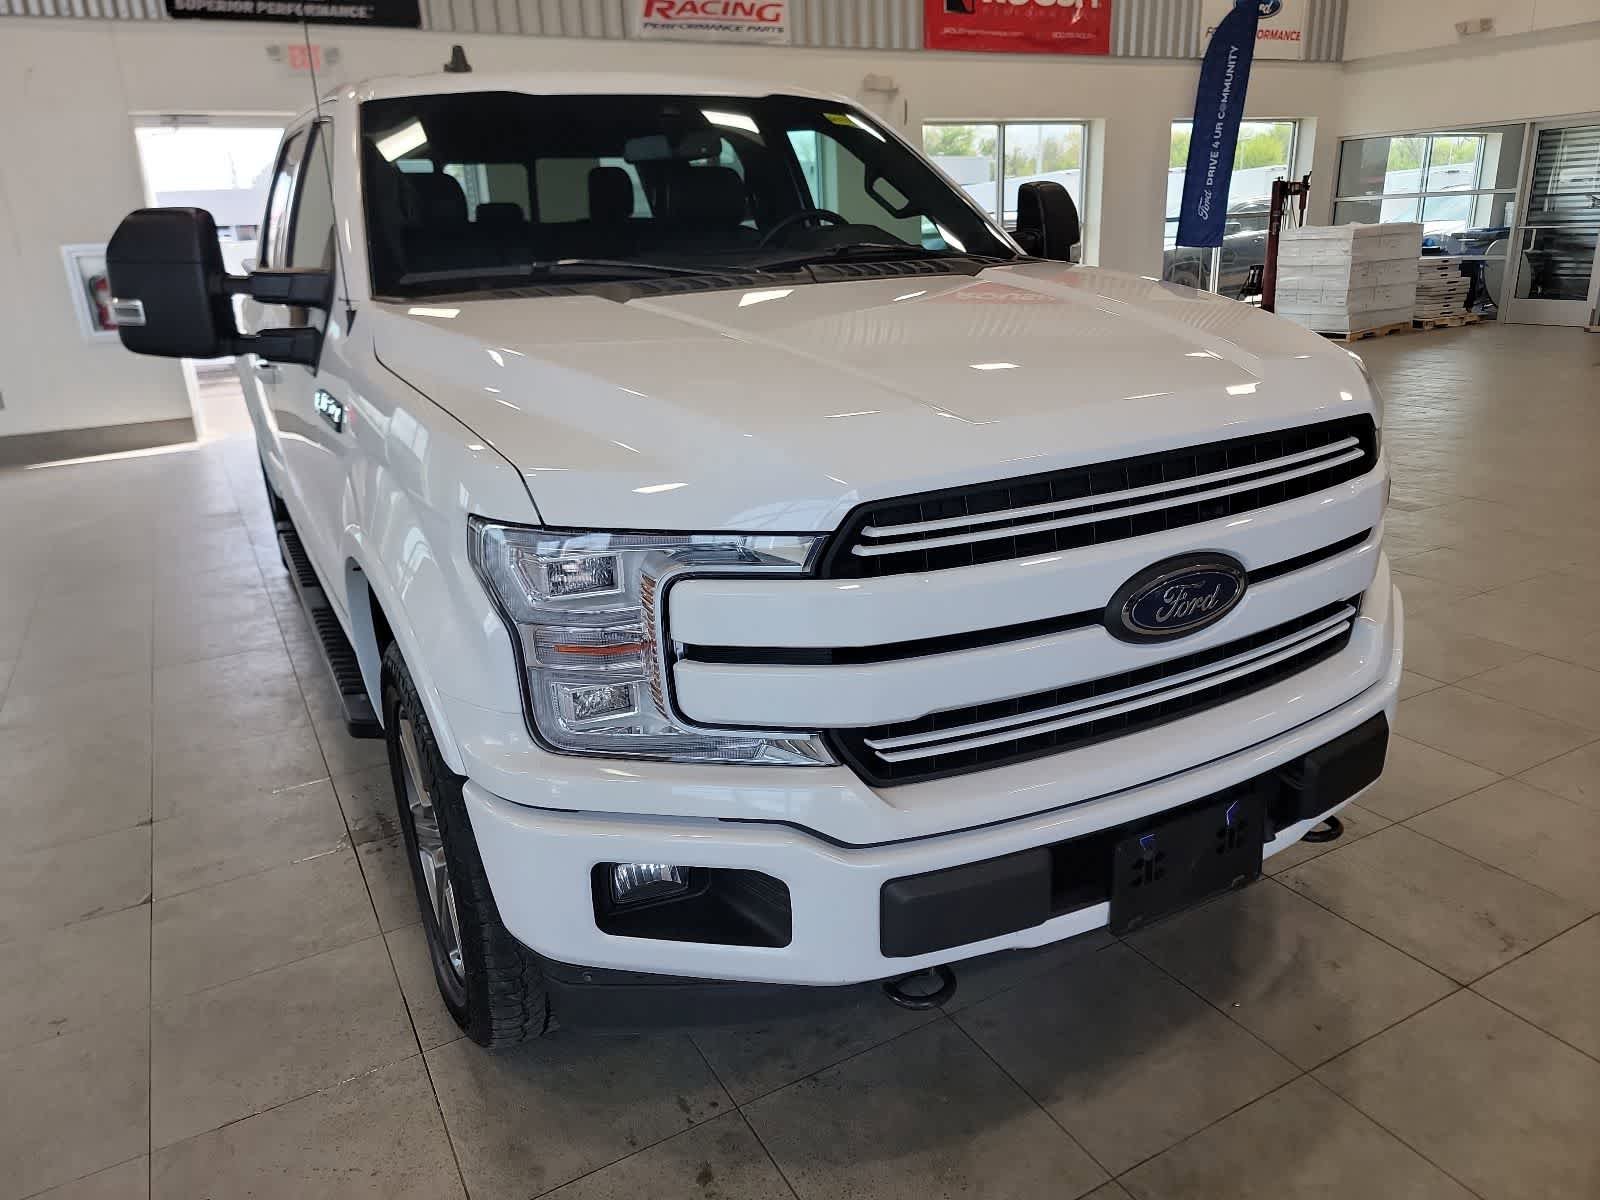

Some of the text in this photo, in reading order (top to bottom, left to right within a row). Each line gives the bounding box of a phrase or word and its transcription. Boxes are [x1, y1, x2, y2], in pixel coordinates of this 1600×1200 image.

[255, 1, 368, 18] PERFORMANCE
[643, 0, 785, 22] RACING
[643, 22, 785, 33] PERFORMANCE PARTS
[1198, 45, 1239, 221] Ford DRIVE 4 UR COMMUNITY
[1155, 580, 1222, 623] Ford
